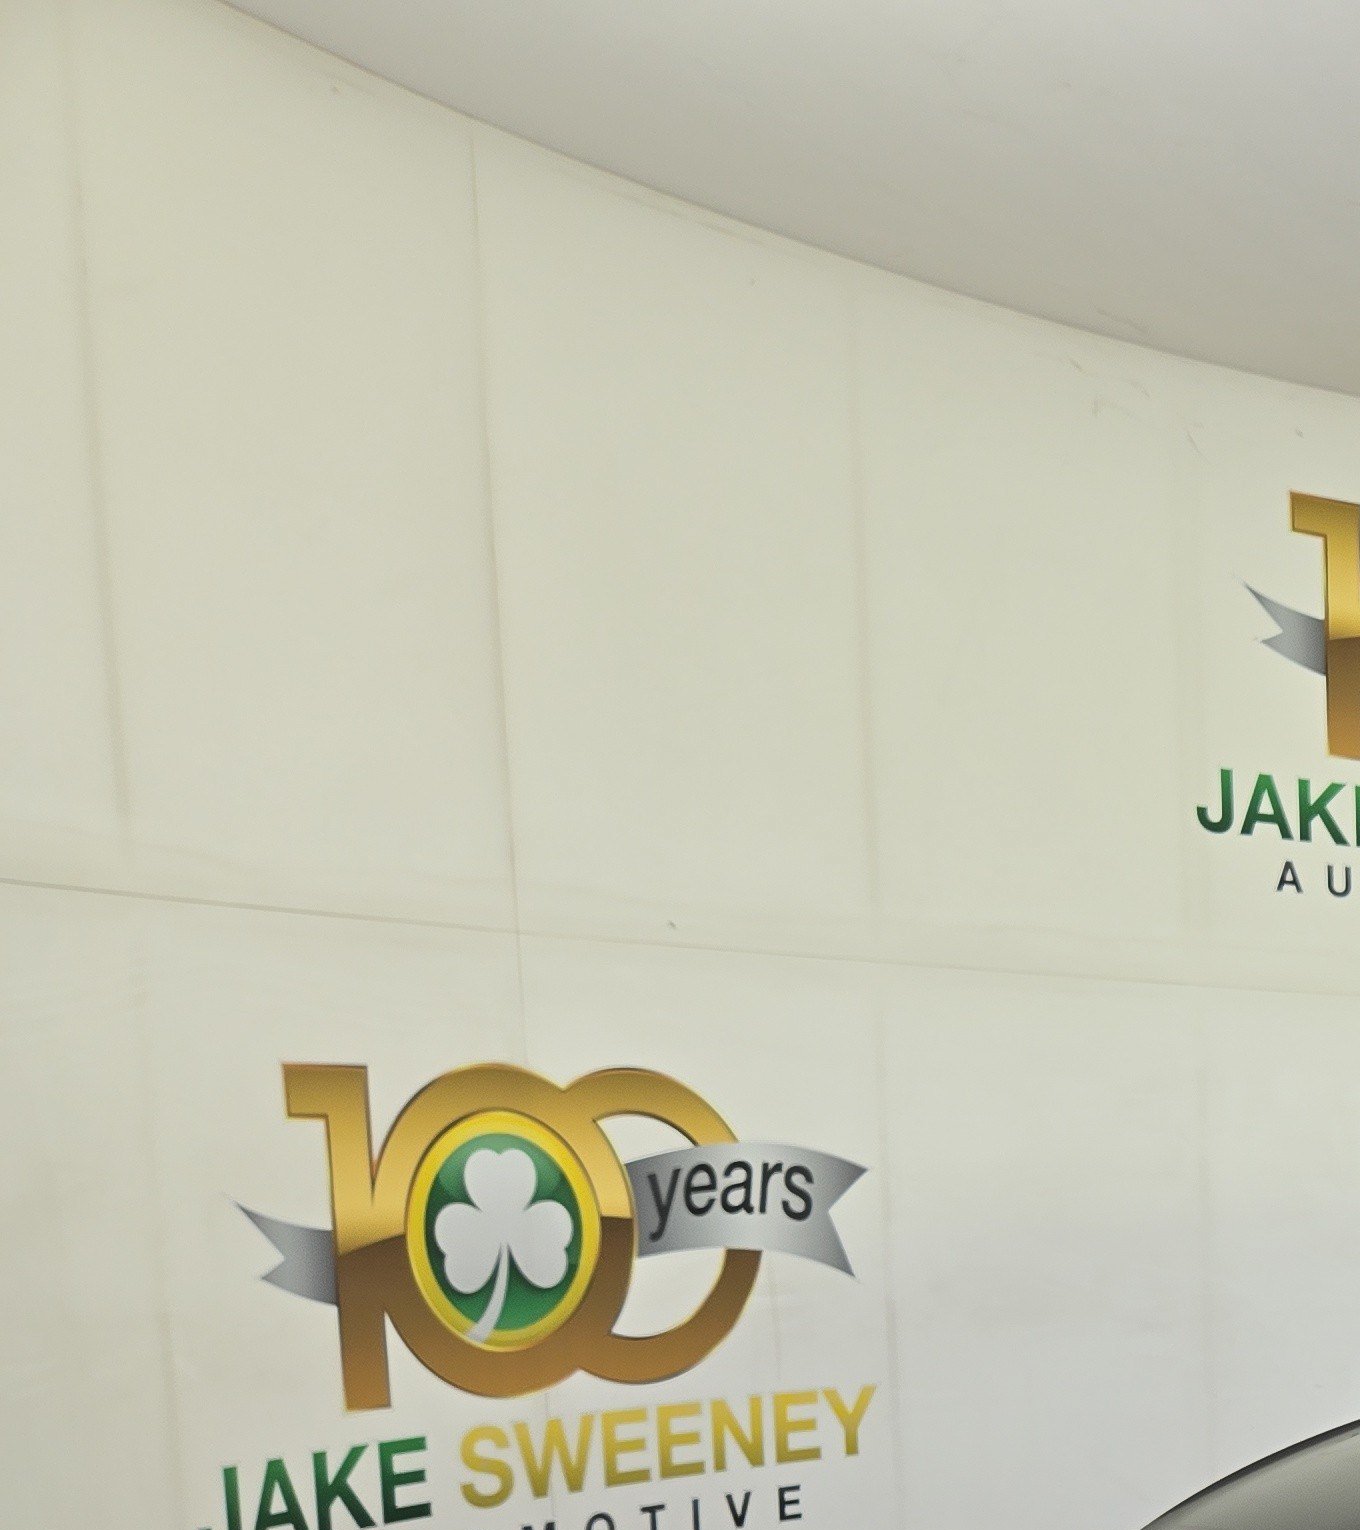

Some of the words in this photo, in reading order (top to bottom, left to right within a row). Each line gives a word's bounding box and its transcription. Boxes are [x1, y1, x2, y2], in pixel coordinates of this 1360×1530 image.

[281, 1061, 764, 1412] 100
[646, 1160, 815, 1242] years
[459, 1385, 878, 1510] SWEENEY
